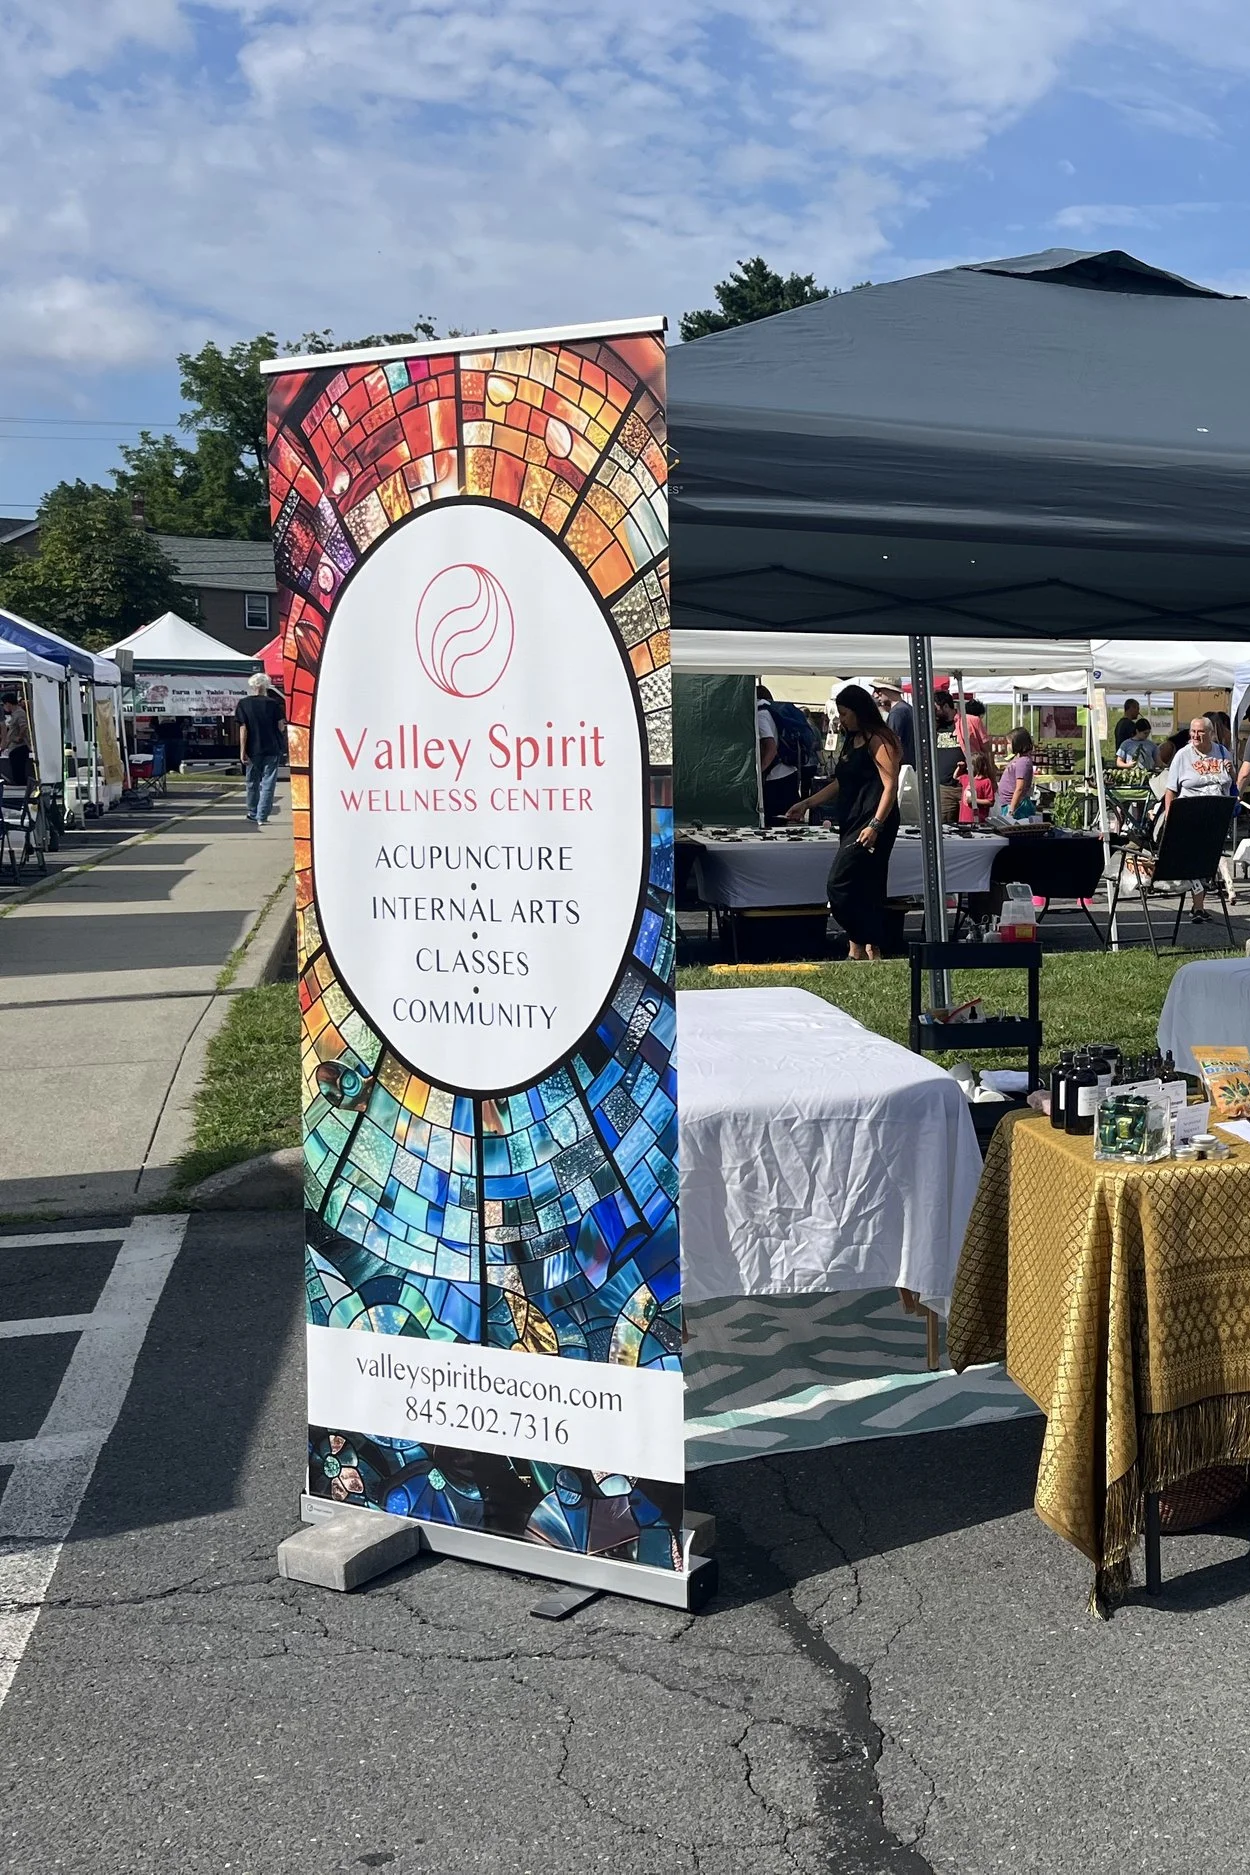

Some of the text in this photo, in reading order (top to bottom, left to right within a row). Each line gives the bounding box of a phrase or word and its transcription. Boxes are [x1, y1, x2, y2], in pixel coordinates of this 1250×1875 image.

[335, 720, 605, 781] Valley Spirit
[340, 787, 593, 813] WELLNESS CENTER
[374, 845, 573, 871] ACUPUNCTURE
[372, 896, 580, 924] INTERNAL ARTS
[415, 947, 529, 976] CLASSES
[392, 997, 557, 1030] COMMUNITY
[356, 1352, 623, 1412] valleyspiritbeacon.com
[405, 1396, 569, 1445] 845.202.7316
